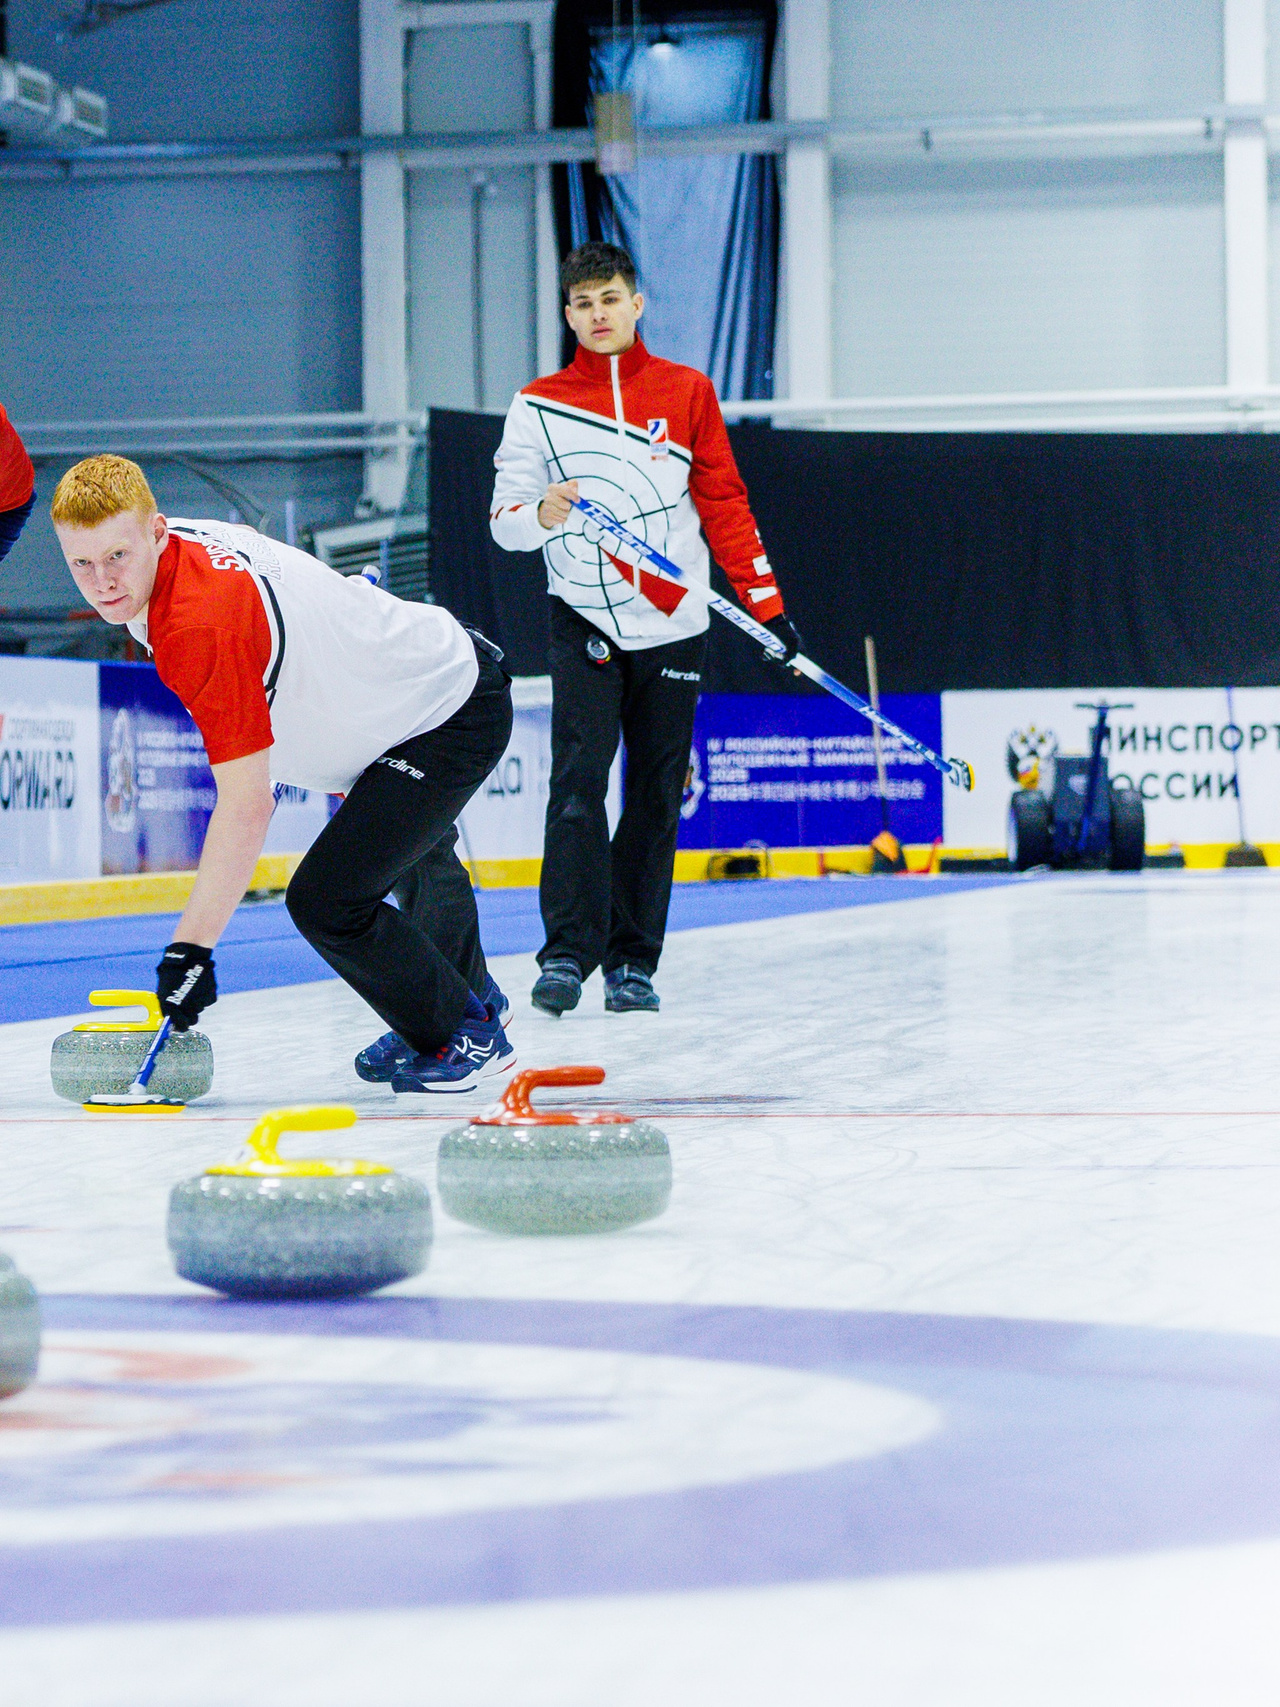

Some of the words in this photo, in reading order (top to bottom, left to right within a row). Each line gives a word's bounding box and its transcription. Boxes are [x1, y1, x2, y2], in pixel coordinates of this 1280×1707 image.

[583, 504, 655, 557] Hardline
[708, 598, 787, 656] Hardlin
[1110, 773, 1239, 800] ОССИИ
